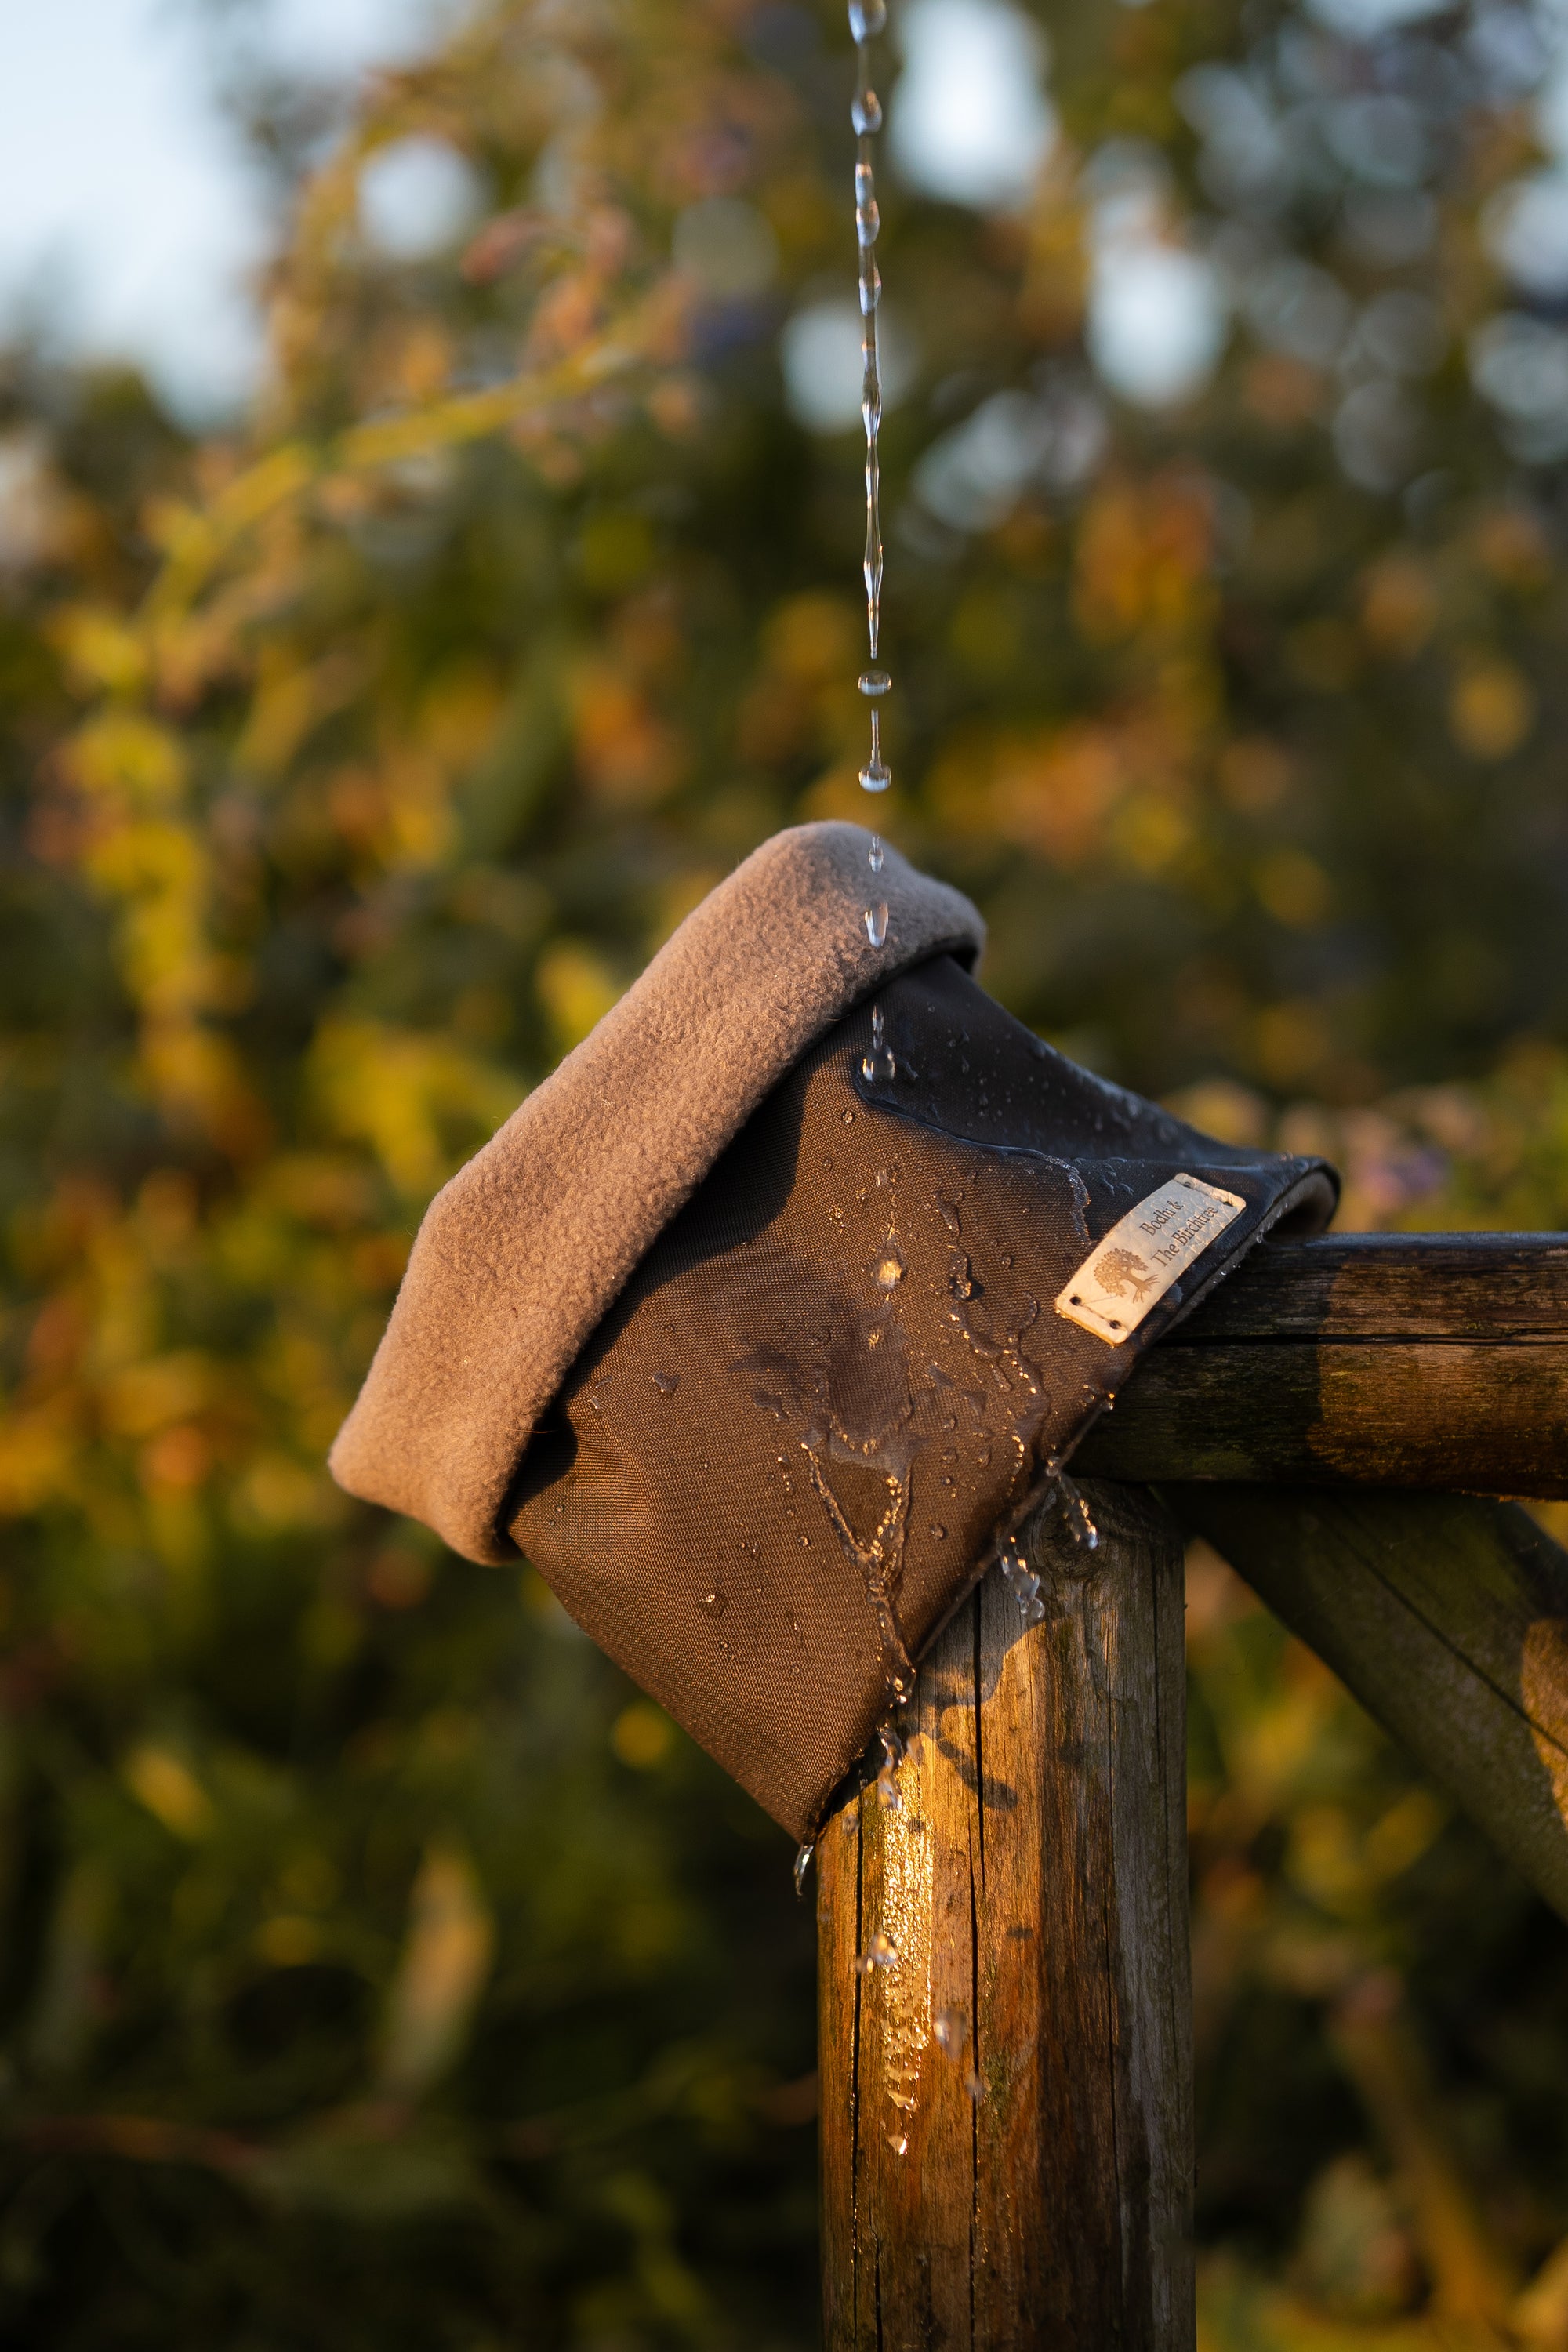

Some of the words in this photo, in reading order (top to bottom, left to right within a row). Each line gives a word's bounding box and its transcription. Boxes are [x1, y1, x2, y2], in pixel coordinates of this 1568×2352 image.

[1139, 1206, 1176, 1236] Bodhi
[1167, 1200, 1184, 1210] &
[1150, 1243, 1180, 1267] The
[1171, 1207, 1218, 1246] Birchtree
